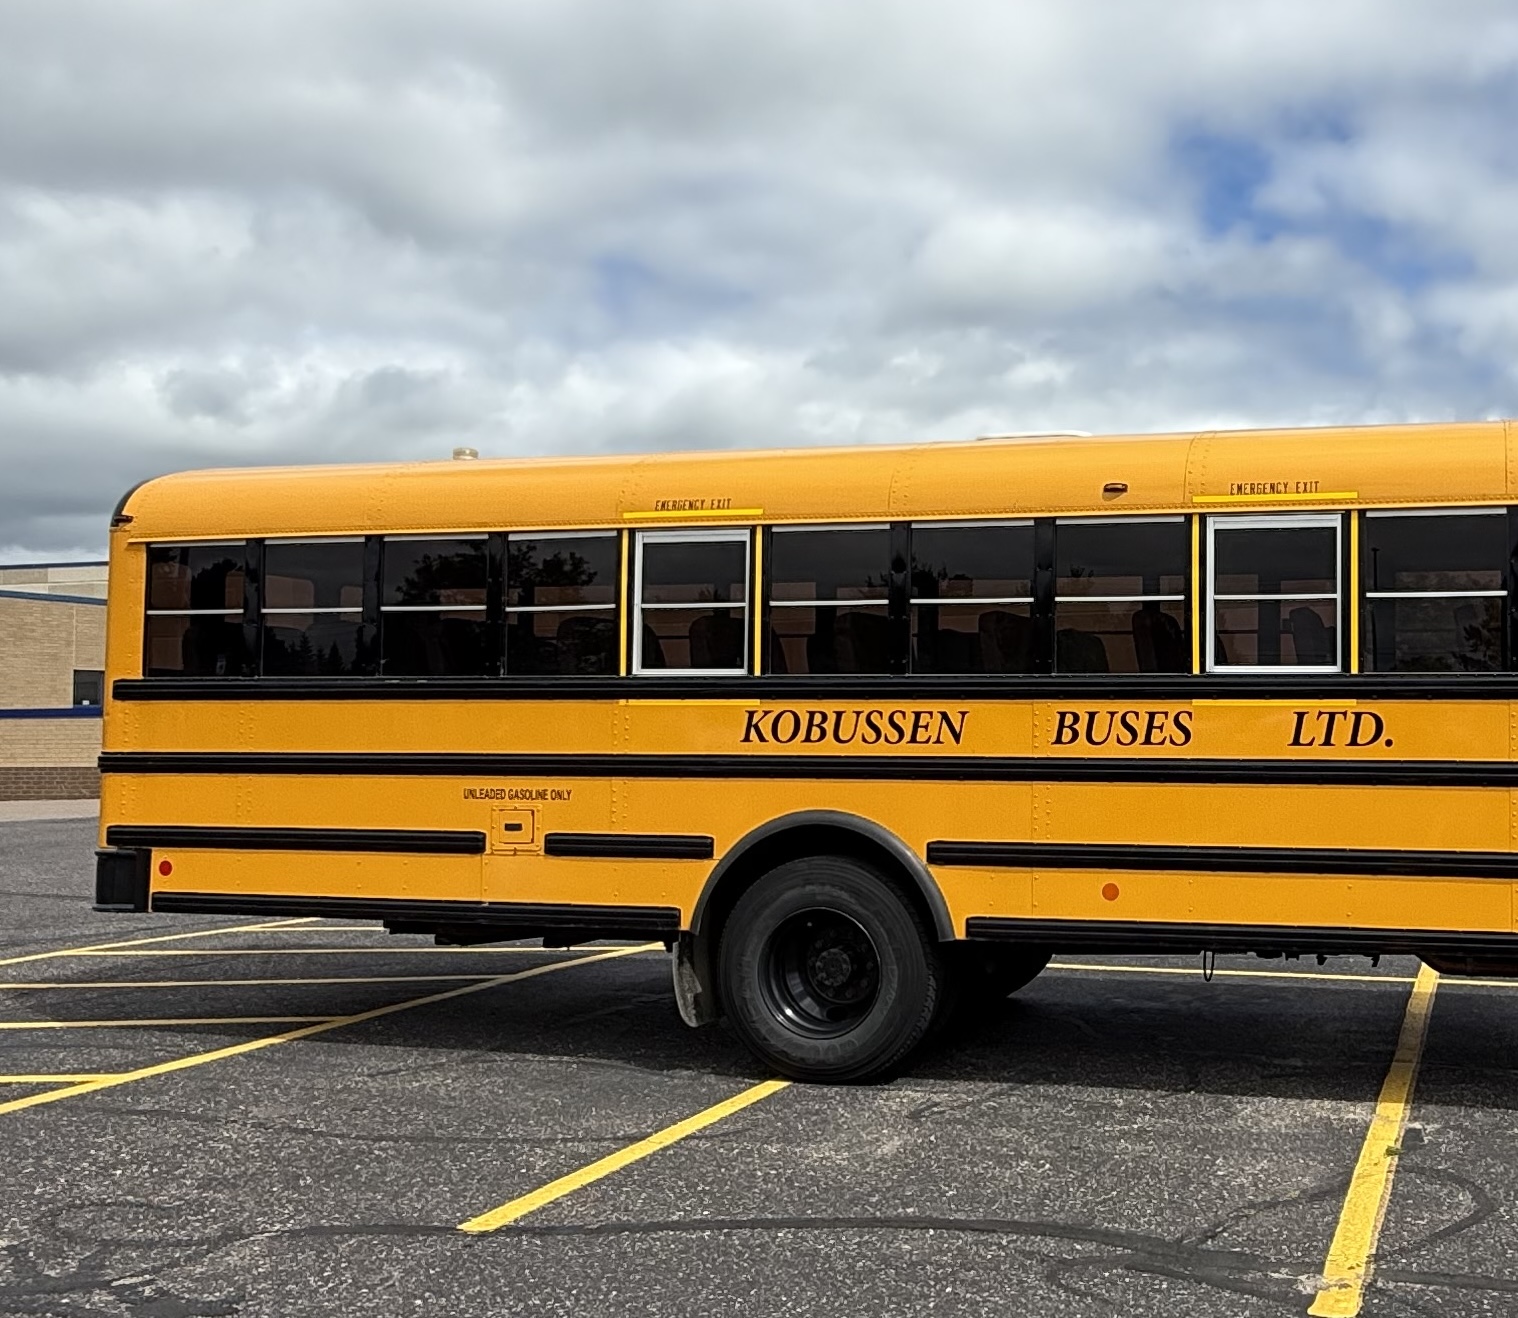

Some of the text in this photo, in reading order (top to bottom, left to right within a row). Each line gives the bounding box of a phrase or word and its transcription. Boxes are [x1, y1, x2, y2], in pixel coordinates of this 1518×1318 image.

[1230, 480, 1320, 496] EMERGENCY EXIT
[655, 498, 732, 512] EMERGENCY EXIT
[739, 709, 1395, 749] KOBUSSEN BUSES LTD.
[463, 788, 573, 801] UNLEADED GASOLINE ONLY
